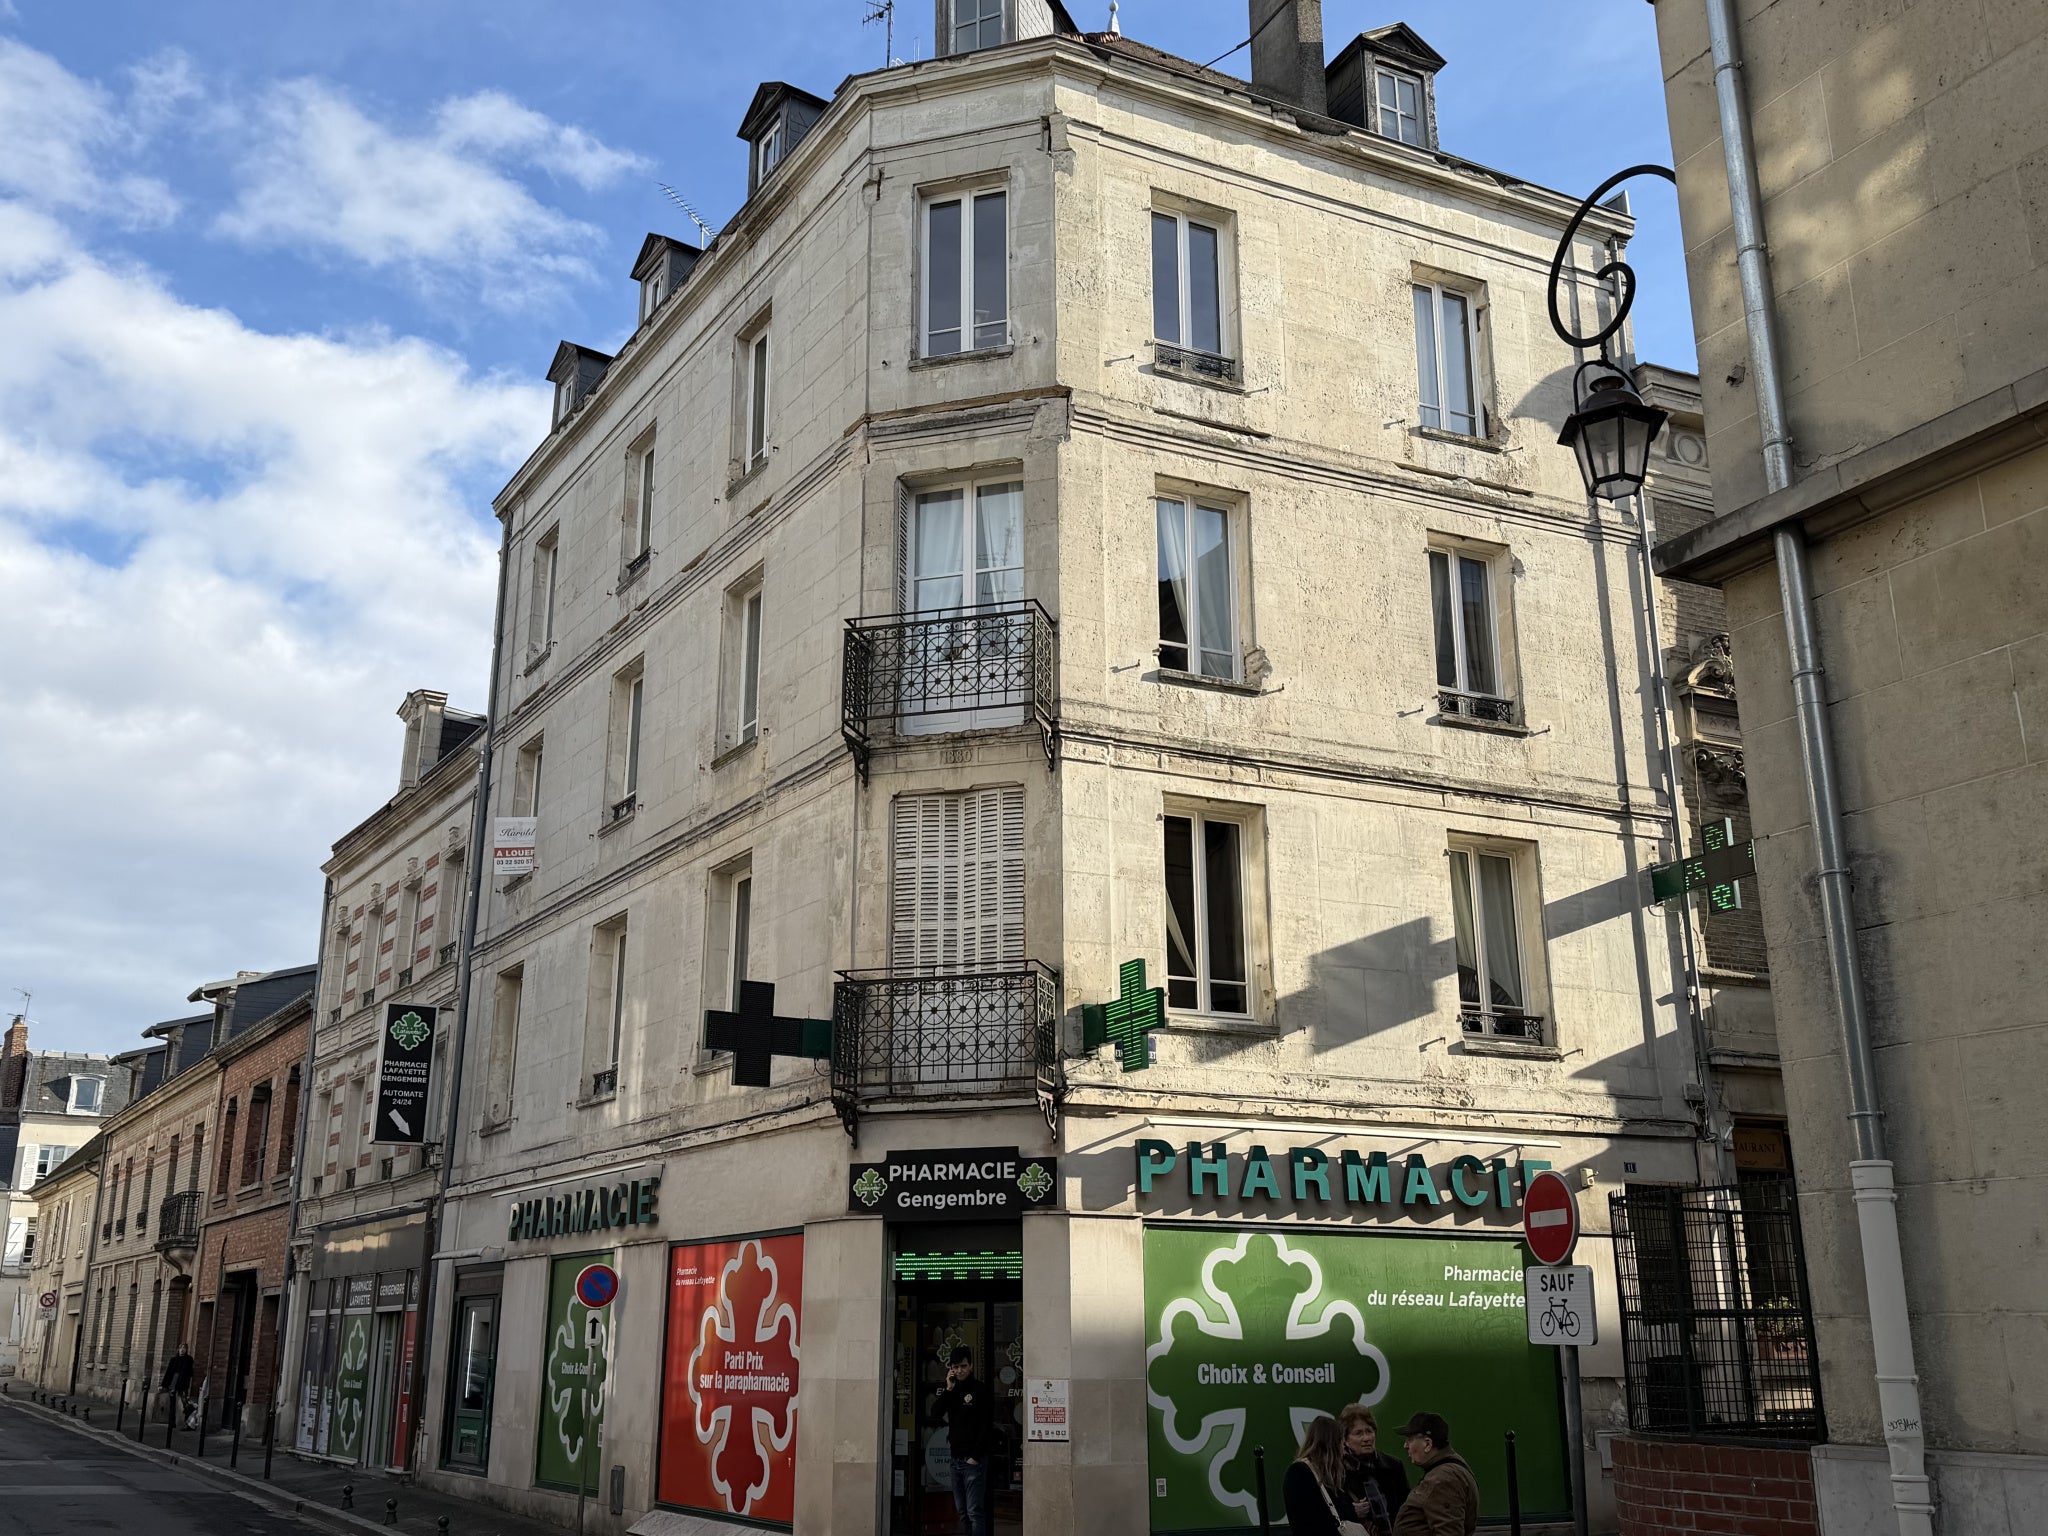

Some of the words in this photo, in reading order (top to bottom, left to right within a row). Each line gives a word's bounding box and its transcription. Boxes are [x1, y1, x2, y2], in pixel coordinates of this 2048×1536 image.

[384, 1060, 428, 1069] PHARMACIE
[384, 1067, 427, 1075] LAFAYETTE
[382, 1075, 427, 1084] GENGEMBRE
[382, 1089, 424, 1098] AUTOMATE
[392, 1098, 412, 1106] 24/24
[889, 1161, 1016, 1182] PHARMACIE
[897, 1190, 1007, 1209] Gengembre
[508, 1177, 659, 1242] PHARMACIE
[1443, 1265, 1524, 1282] Pharmacie
[1540, 1273, 1575, 1292] SAUF
[350, 1280, 373, 1293] PHARMACIE
[349, 1294, 371, 1307] LAFAYETTE
[1367, 1290, 1388, 1306] du
[1391, 1289, 1445, 1307] réseau
[1449, 1290, 1526, 1310] Lafayette
[724, 1350, 745, 1370] Parti
[746, 1350, 764, 1371] Prix
[699, 1373, 714, 1389] sur
[714, 1370, 723, 1389] la
[724, 1371, 790, 1395] parapharmacie
[1197, 1363, 1248, 1385] Choix
[1252, 1363, 1267, 1384] &
[1271, 1363, 1336, 1384] Conseil
